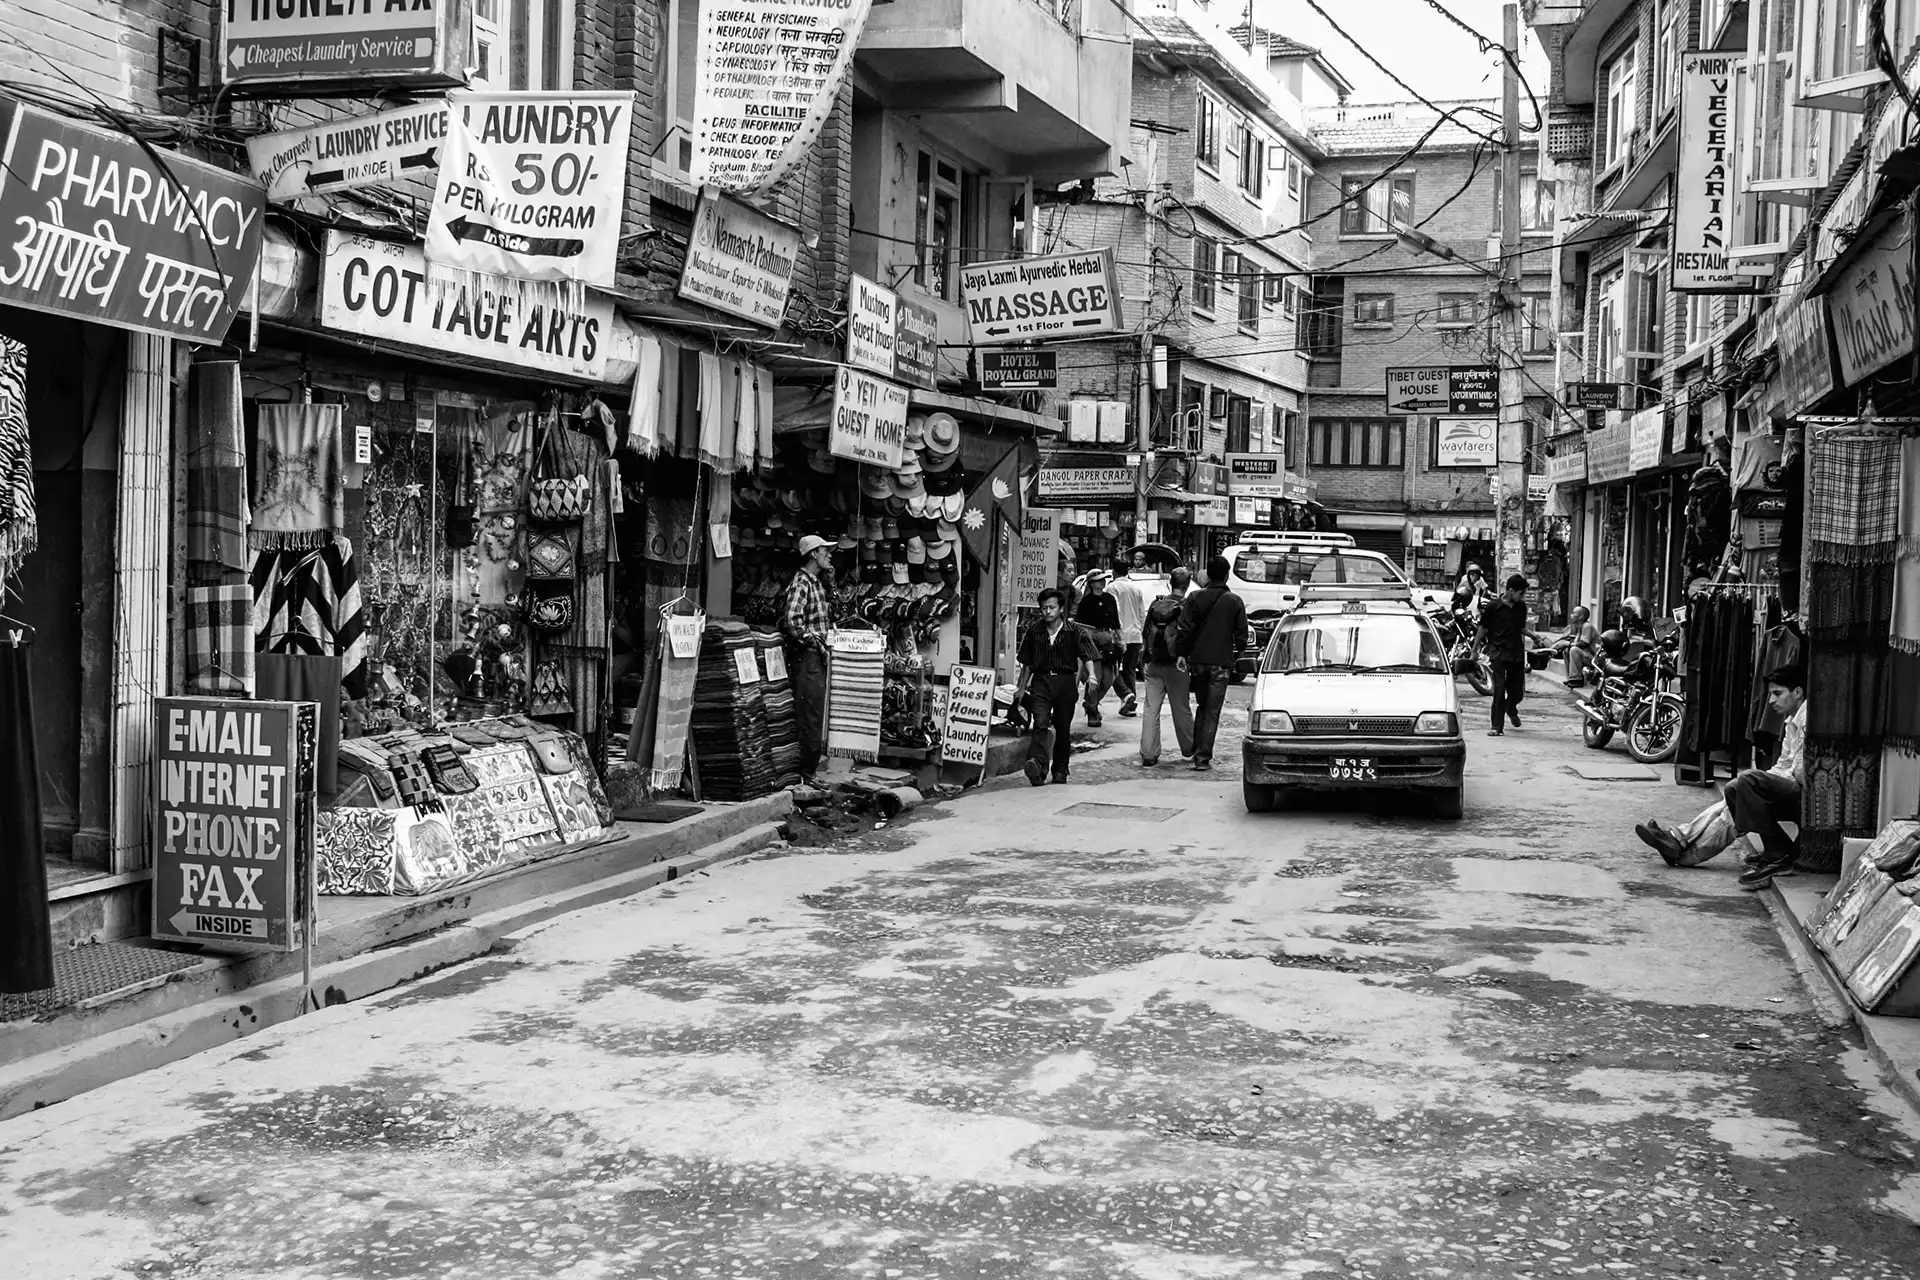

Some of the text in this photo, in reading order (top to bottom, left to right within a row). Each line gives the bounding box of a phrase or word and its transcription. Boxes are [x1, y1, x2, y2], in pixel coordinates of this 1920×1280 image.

[761, 12, 818, 27] PHYSICIANS
[716, 26, 770, 40] NEUROLOGY
[247, 36, 413, 68] Cheapest Laundry Service
[715, 42, 773, 56] CARDIOLOGY
[714, 57, 777, 71] GYNAECOLOGY
[712, 117, 737, 128] DRUG
[259, 166, 275, 187] The
[315, 123, 381, 159] LAUNDRY
[386, 110, 448, 147] SERVICE
[710, 132, 738, 144] CHECK
[740, 133, 776, 145] BLOOD
[1702, 78, 1728, 249] VEGETARIAN
[511, 152, 598, 196] 50/-
[31, 139, 257, 250] PHARMACY
[445, 181, 596, 229] PER KILOGRAM
[483, 228, 531, 253] Inside
[712, 215, 793, 281] Namaste Pashmina
[964, 256, 1102, 292] Jaya Laxmi Ayurvedic Herbal
[343, 256, 599, 362] COTTAGE ARTS
[969, 285, 1108, 325] MASSAGE
[852, 313, 894, 351] Guest House
[1016, 320, 1065, 333] 1st Floor
[896, 333, 916, 360] Guest
[916, 340, 935, 368] House
[1000, 354, 1039, 367] HOTEL
[985, 368, 1056, 381] ROYAL GRAND
[1389, 370, 1448, 382] TIBET GUEST
[857, 379, 877, 409] YETI
[1400, 384, 1439, 395] HOUSE
[1567, 385, 1580, 406] 1
[837, 405, 903, 449] GUEST HOME
[1440, 441, 1495, 454] wayfarers
[1040, 470, 1134, 481] DANGOL PAPER CRAFT
[1019, 538, 1050, 549] ADVANCE
[1022, 550, 1045, 562] PHOTO
[1020, 564, 1047, 576] SYSTEM
[1017, 577, 1047, 589] FILM DEV
[968, 672, 992, 686] Yeti
[951, 686, 988, 701] Guest
[949, 702, 988, 718] Home
[169, 708, 272, 757] E-MAIL
[946, 725, 988, 746] Laundry
[943, 743, 983, 760] Service
[160, 759, 286, 810] INTERNET
[164, 810, 281, 860] PHONE
[180, 863, 263, 911] FAX
[196, 915, 252, 935] INSIDE
